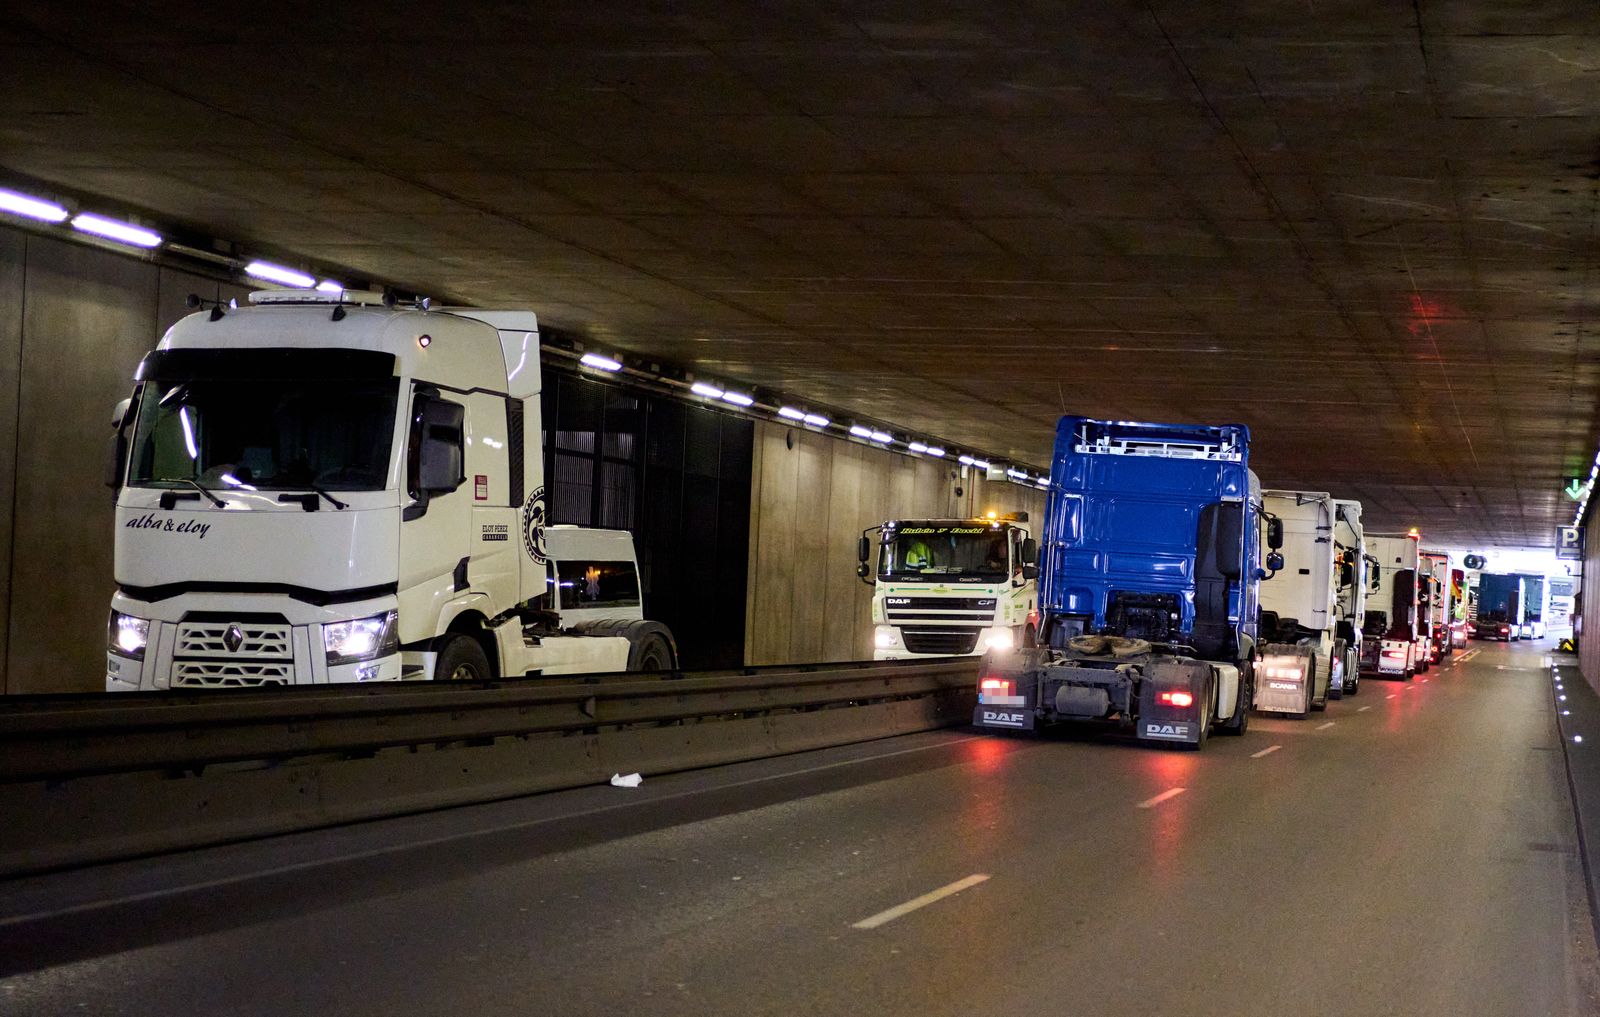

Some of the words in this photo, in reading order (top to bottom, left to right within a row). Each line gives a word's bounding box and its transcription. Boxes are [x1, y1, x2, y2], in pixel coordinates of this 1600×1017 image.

[126, 513, 163, 529] alba
[163, 518, 174, 531] &
[176, 519, 211, 539] eloy
[1562, 528, 1579, 547] P
[1270, 682, 1297, 690] SCANIA
[983, 711, 1024, 722] DAF
[1146, 724, 1188, 735] DAF
